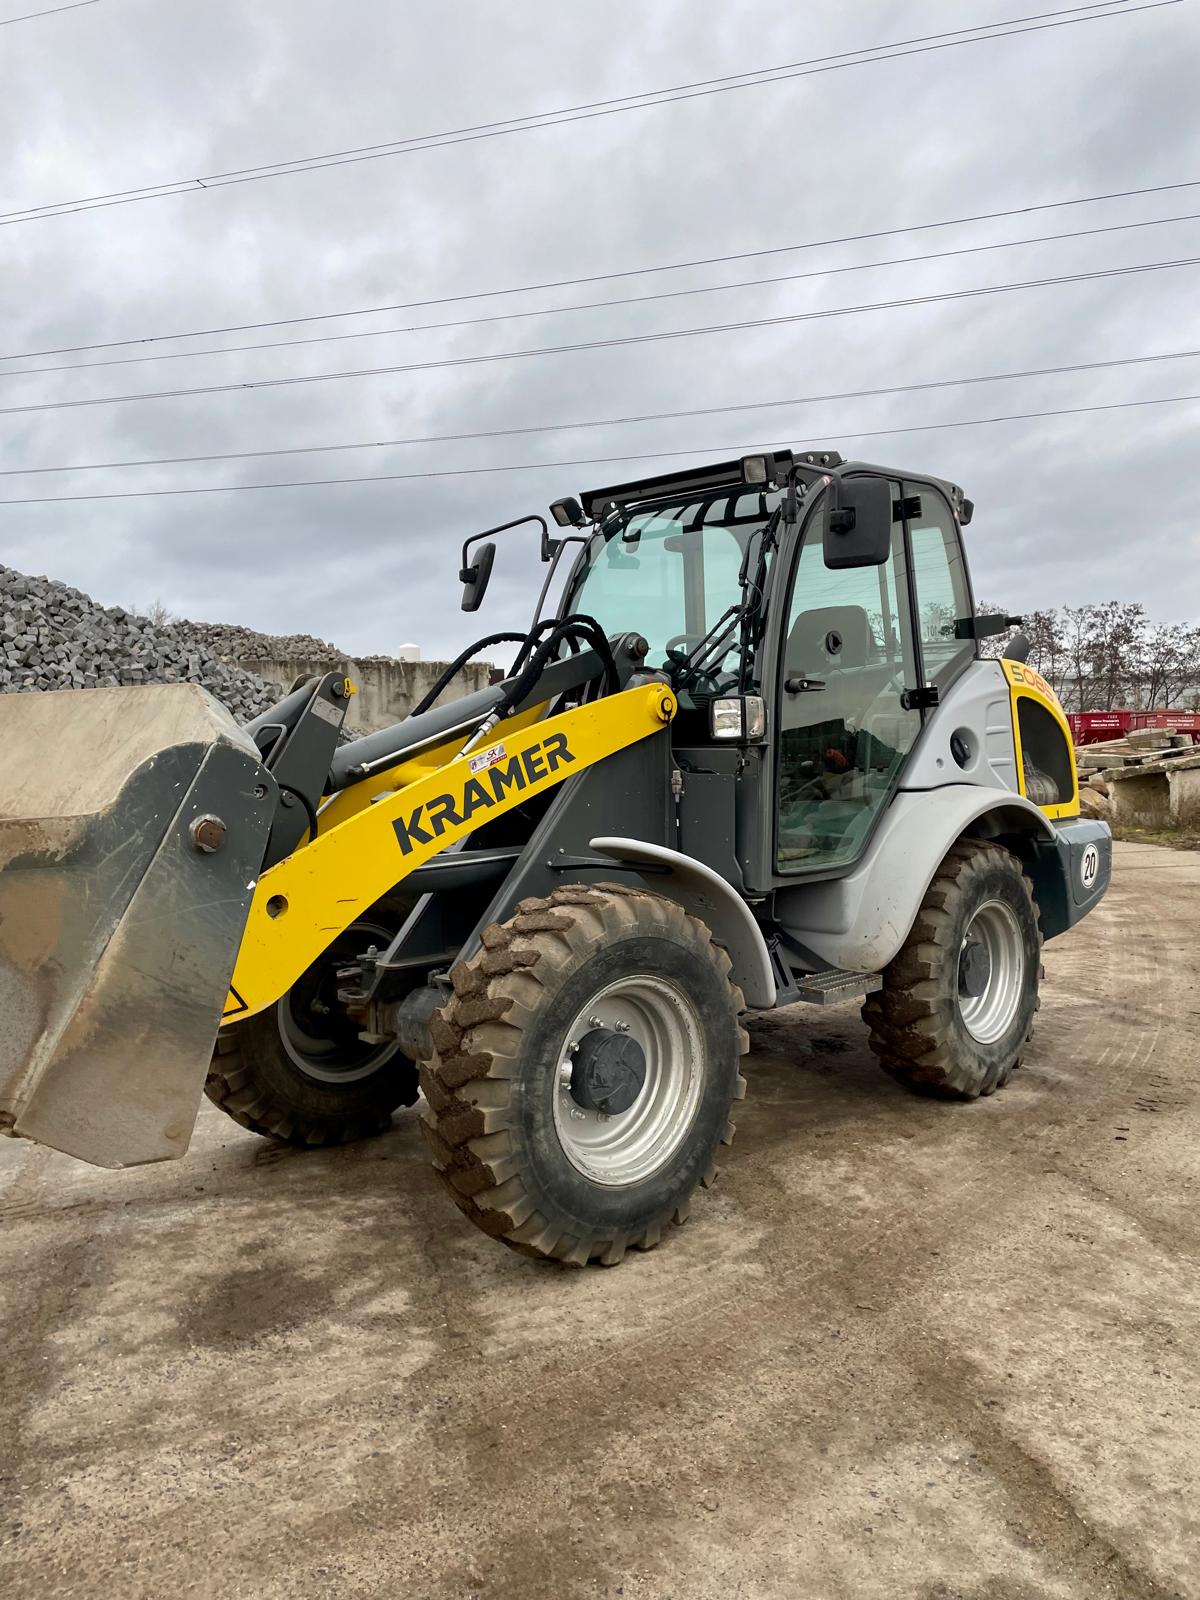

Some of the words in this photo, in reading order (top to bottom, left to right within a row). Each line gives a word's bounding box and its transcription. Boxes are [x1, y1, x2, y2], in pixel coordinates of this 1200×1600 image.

[1010, 664, 1054, 703] 5085
[391, 732, 577, 857] KRAMER
[1084, 852, 1096, 880] 20
